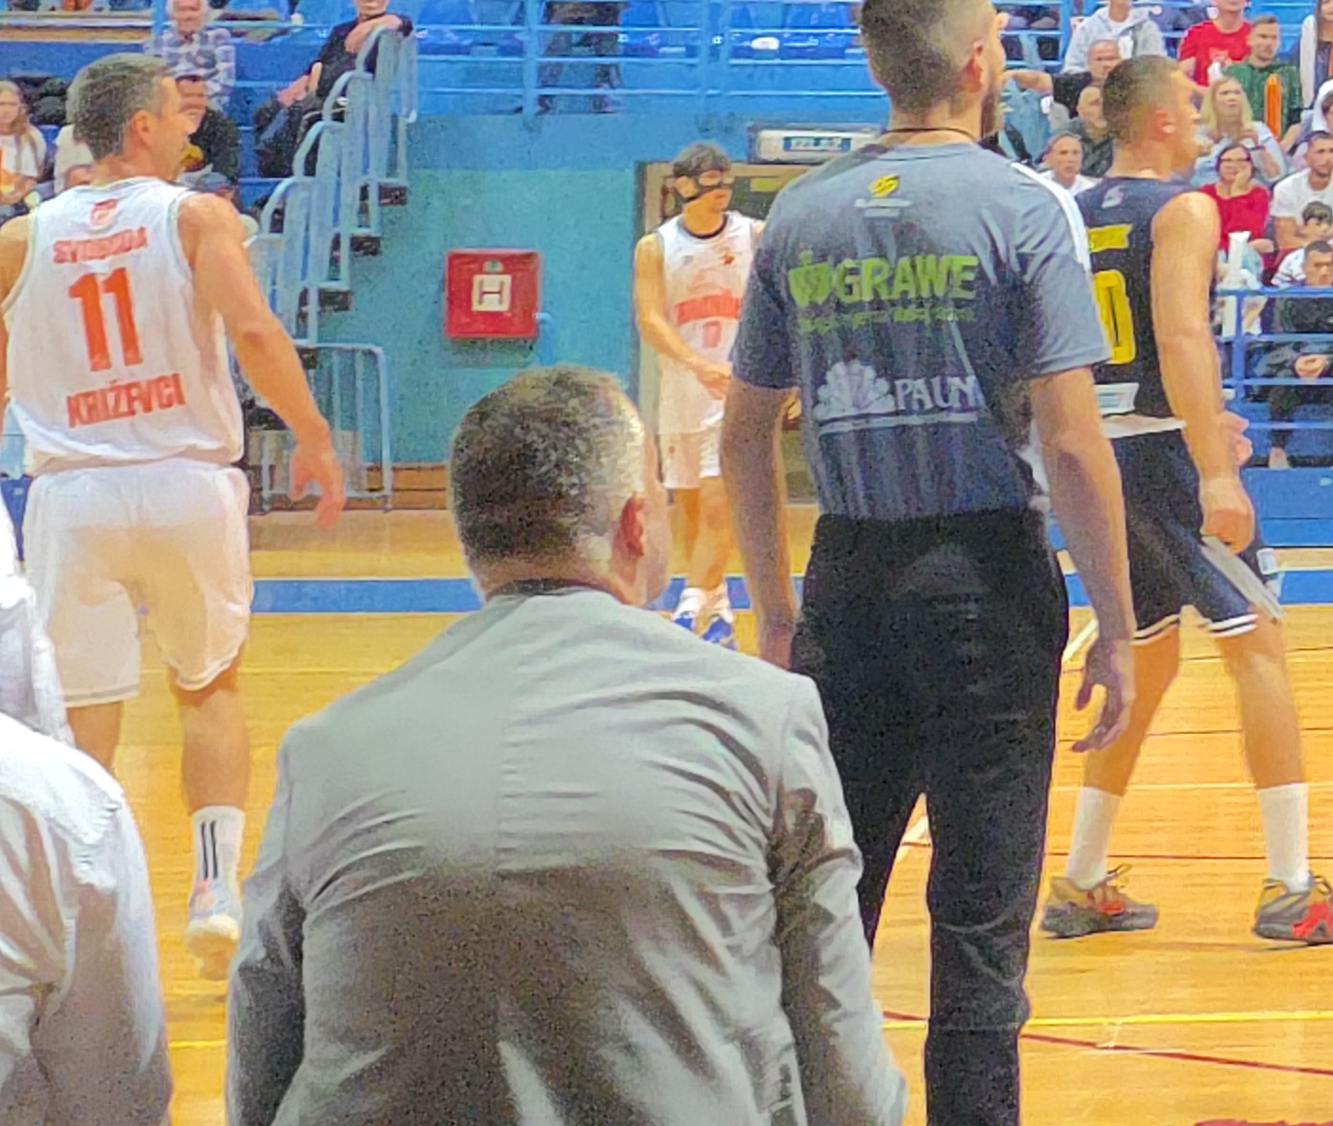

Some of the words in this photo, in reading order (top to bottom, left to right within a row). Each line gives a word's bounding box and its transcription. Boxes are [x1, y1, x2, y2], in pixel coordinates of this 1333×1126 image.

[835, 253, 979, 304] GRAWE
[68, 267, 143, 371] 11
[66, 373, 185, 428] KRIŽEVCI
